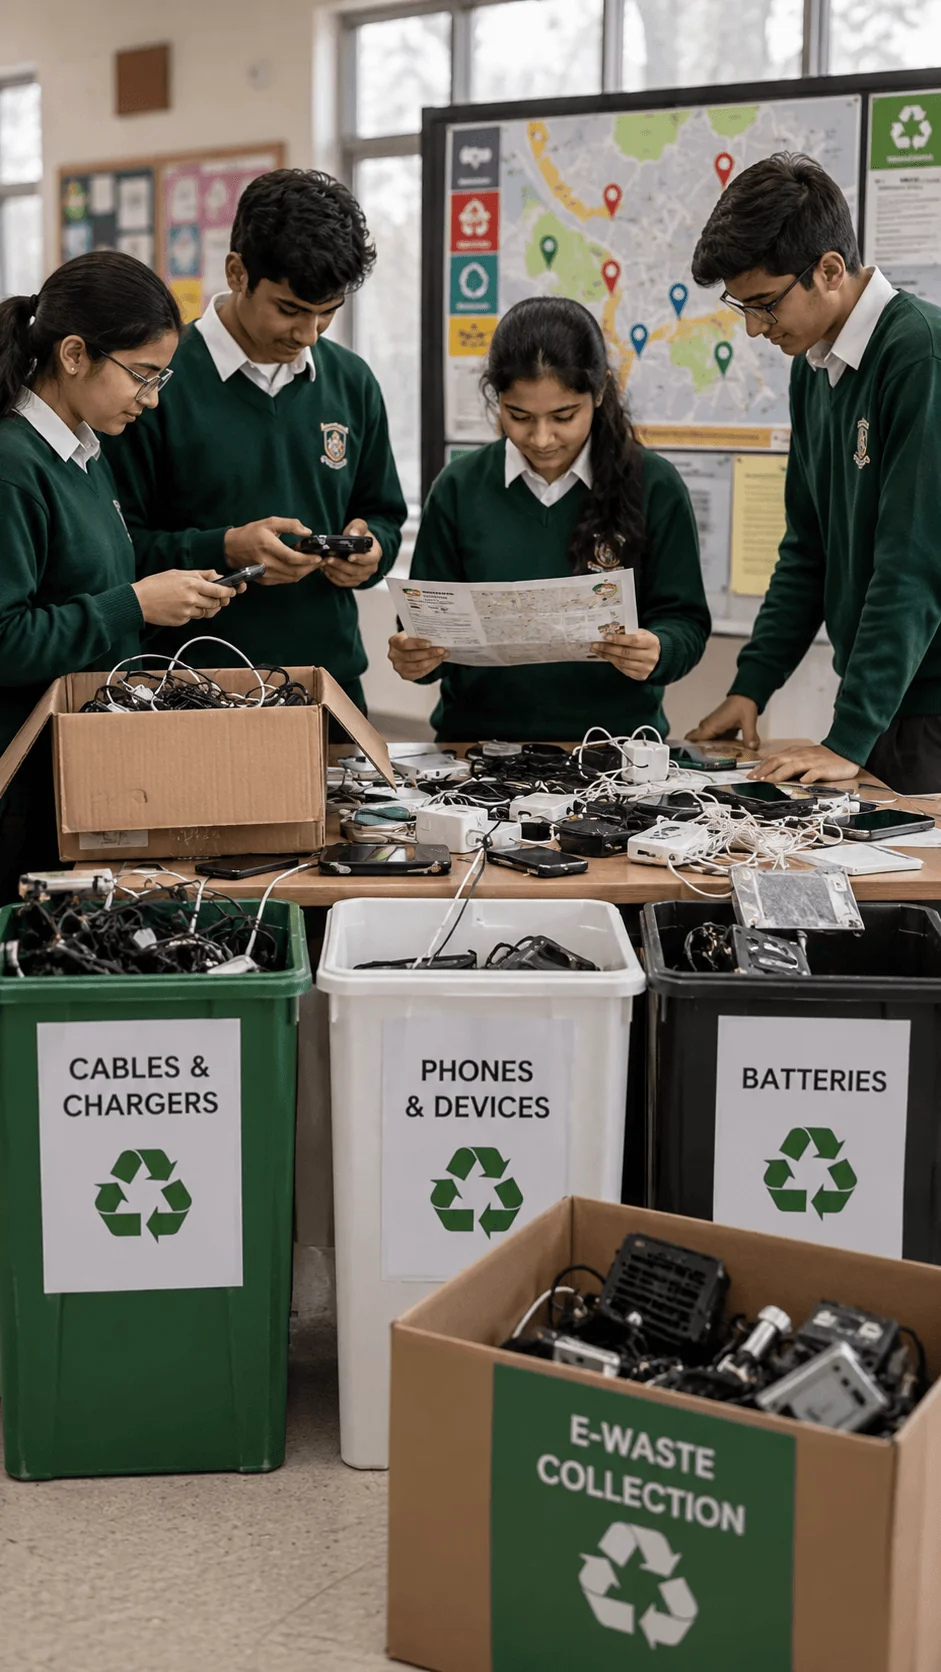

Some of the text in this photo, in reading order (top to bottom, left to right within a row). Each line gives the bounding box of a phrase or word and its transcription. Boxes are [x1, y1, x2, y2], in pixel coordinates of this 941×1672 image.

[69, 1055, 210, 1080] CABLES &
[421, 1059, 534, 1082] PHONES
[742, 1067, 887, 1093] BATTERIES
[63, 1091, 219, 1117] CHARGERS
[405, 1095, 550, 1119] & DEVICES
[570, 1413, 716, 1480] E-WASTE
[536, 1453, 745, 1536] COLLECTION
